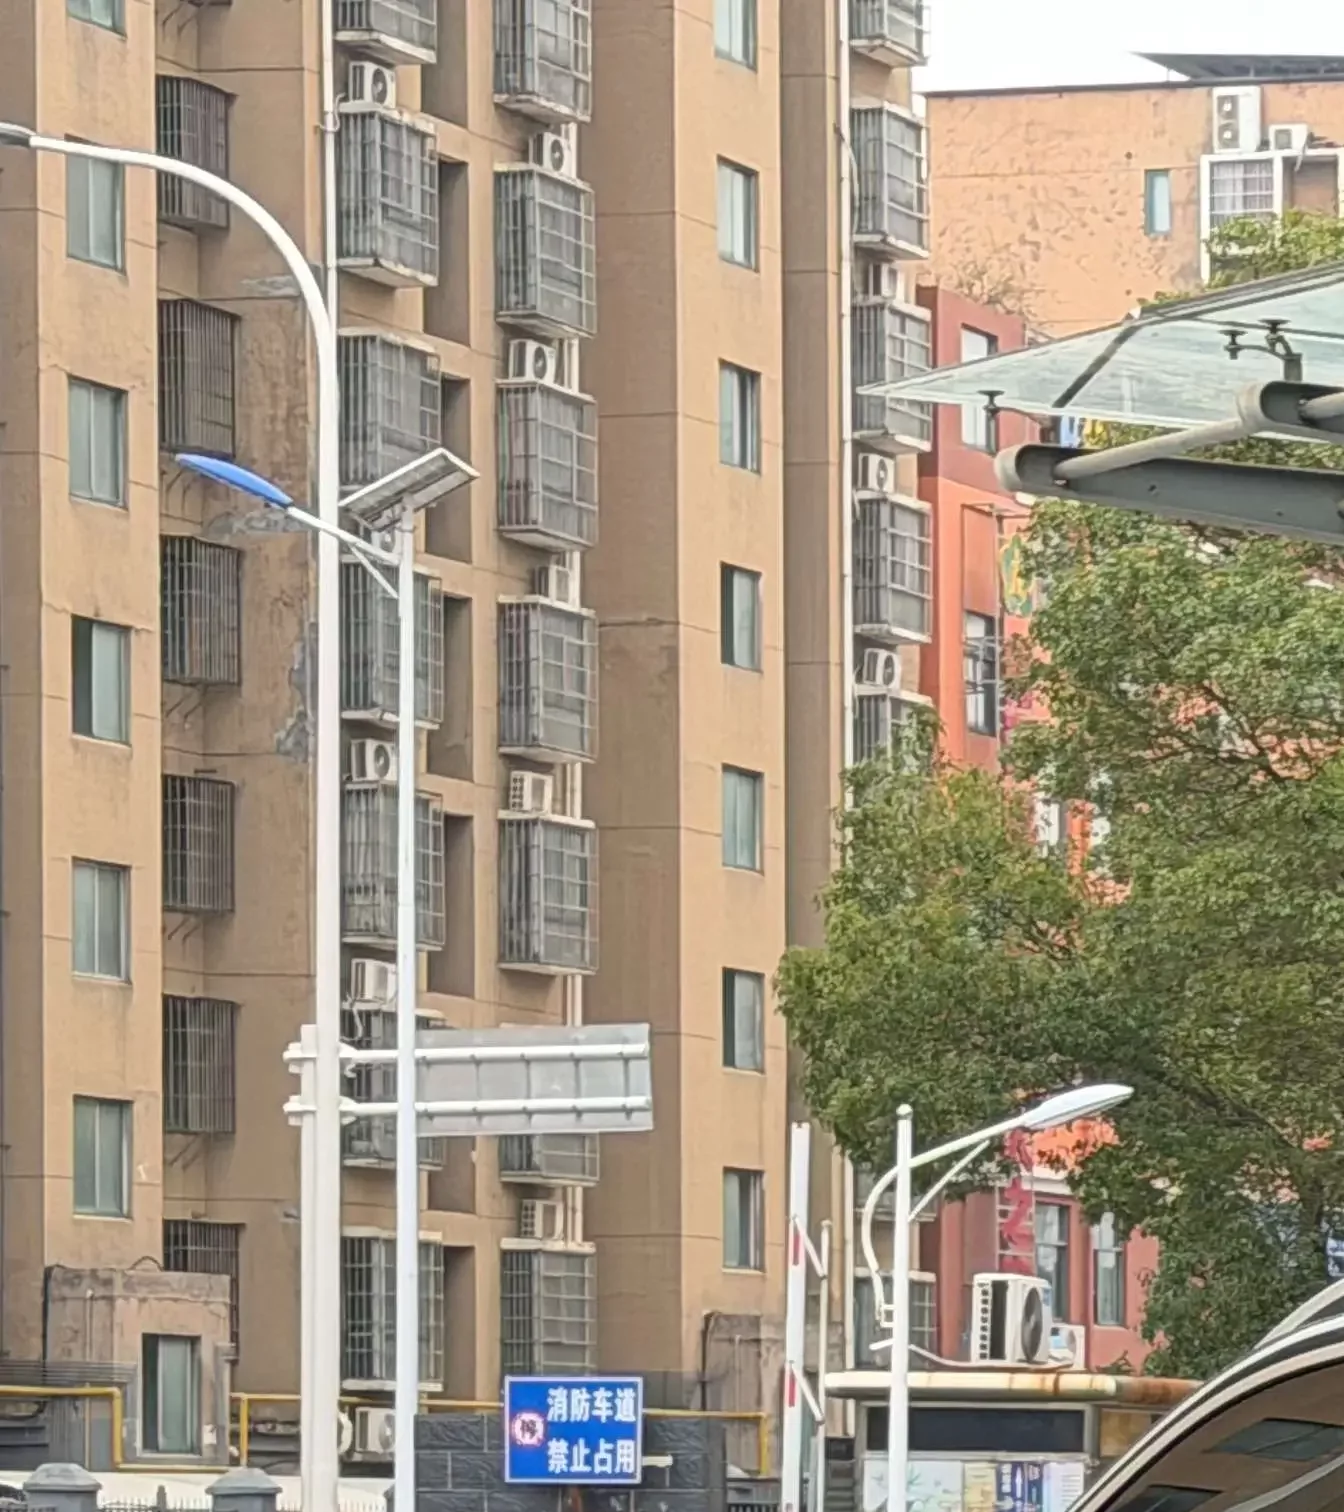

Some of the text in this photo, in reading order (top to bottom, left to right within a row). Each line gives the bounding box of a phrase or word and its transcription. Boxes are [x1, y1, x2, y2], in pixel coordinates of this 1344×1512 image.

[547, 1386, 636, 1423] 消防车道
[547, 1437, 636, 1475] 禁止占用
